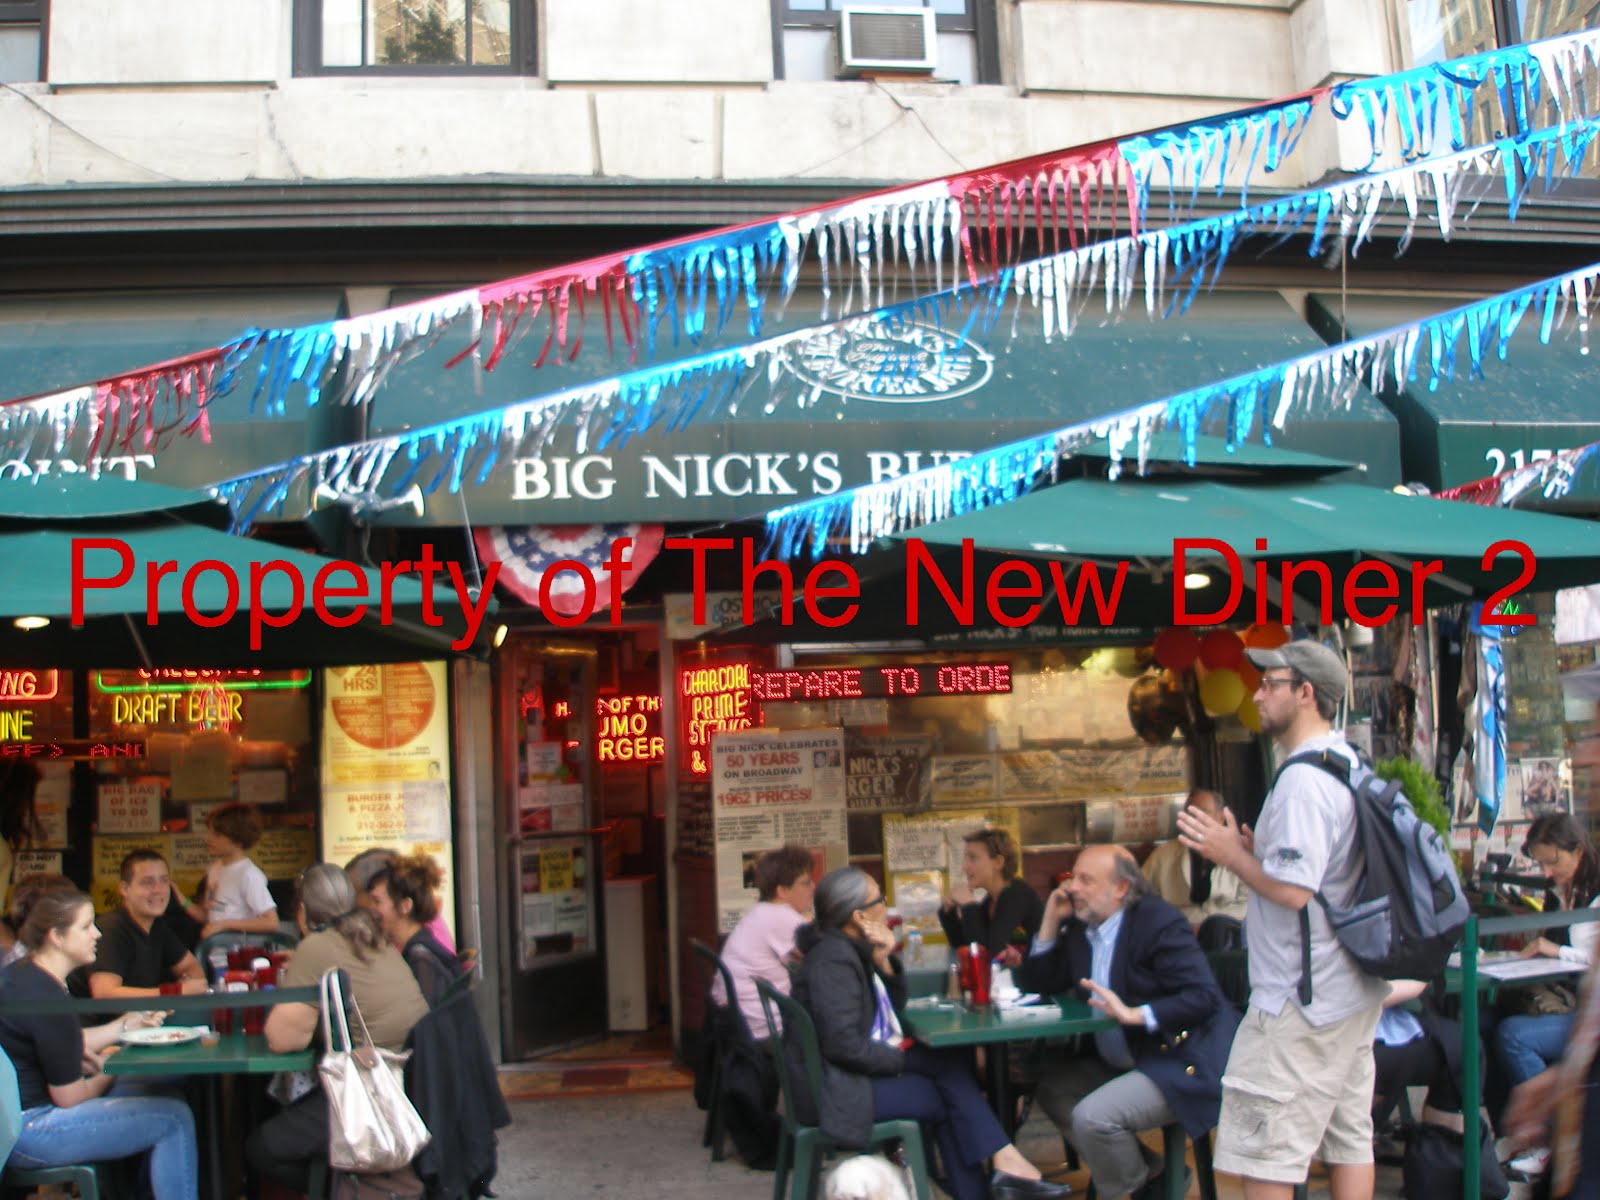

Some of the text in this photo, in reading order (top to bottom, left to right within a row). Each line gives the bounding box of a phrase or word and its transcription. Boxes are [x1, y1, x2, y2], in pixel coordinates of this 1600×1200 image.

[512, 456, 616, 500] BIG
[643, 452, 842, 498] NICK'S
[0, 671, 37, 697] NG
[683, 664, 752, 696] CHARCOAL
[882, 668, 920, 694] TO
[938, 665, 1011, 693] ORDE
[113, 692, 243, 723] DRAFT BEER
[636, 695, 662, 711] TH
[692, 690, 748, 720] PRIME
[716, 739, 839, 753] BIG NICK CELEBRATES
[692, 749, 707, 773] &
[726, 751, 800, 768] 50 YEARS
[849, 756, 902, 775] NICK'S
[724, 767, 804, 779] ON BROADWAY
[718, 792, 752, 806] 1962
[756, 788, 812, 804] PRICES!
